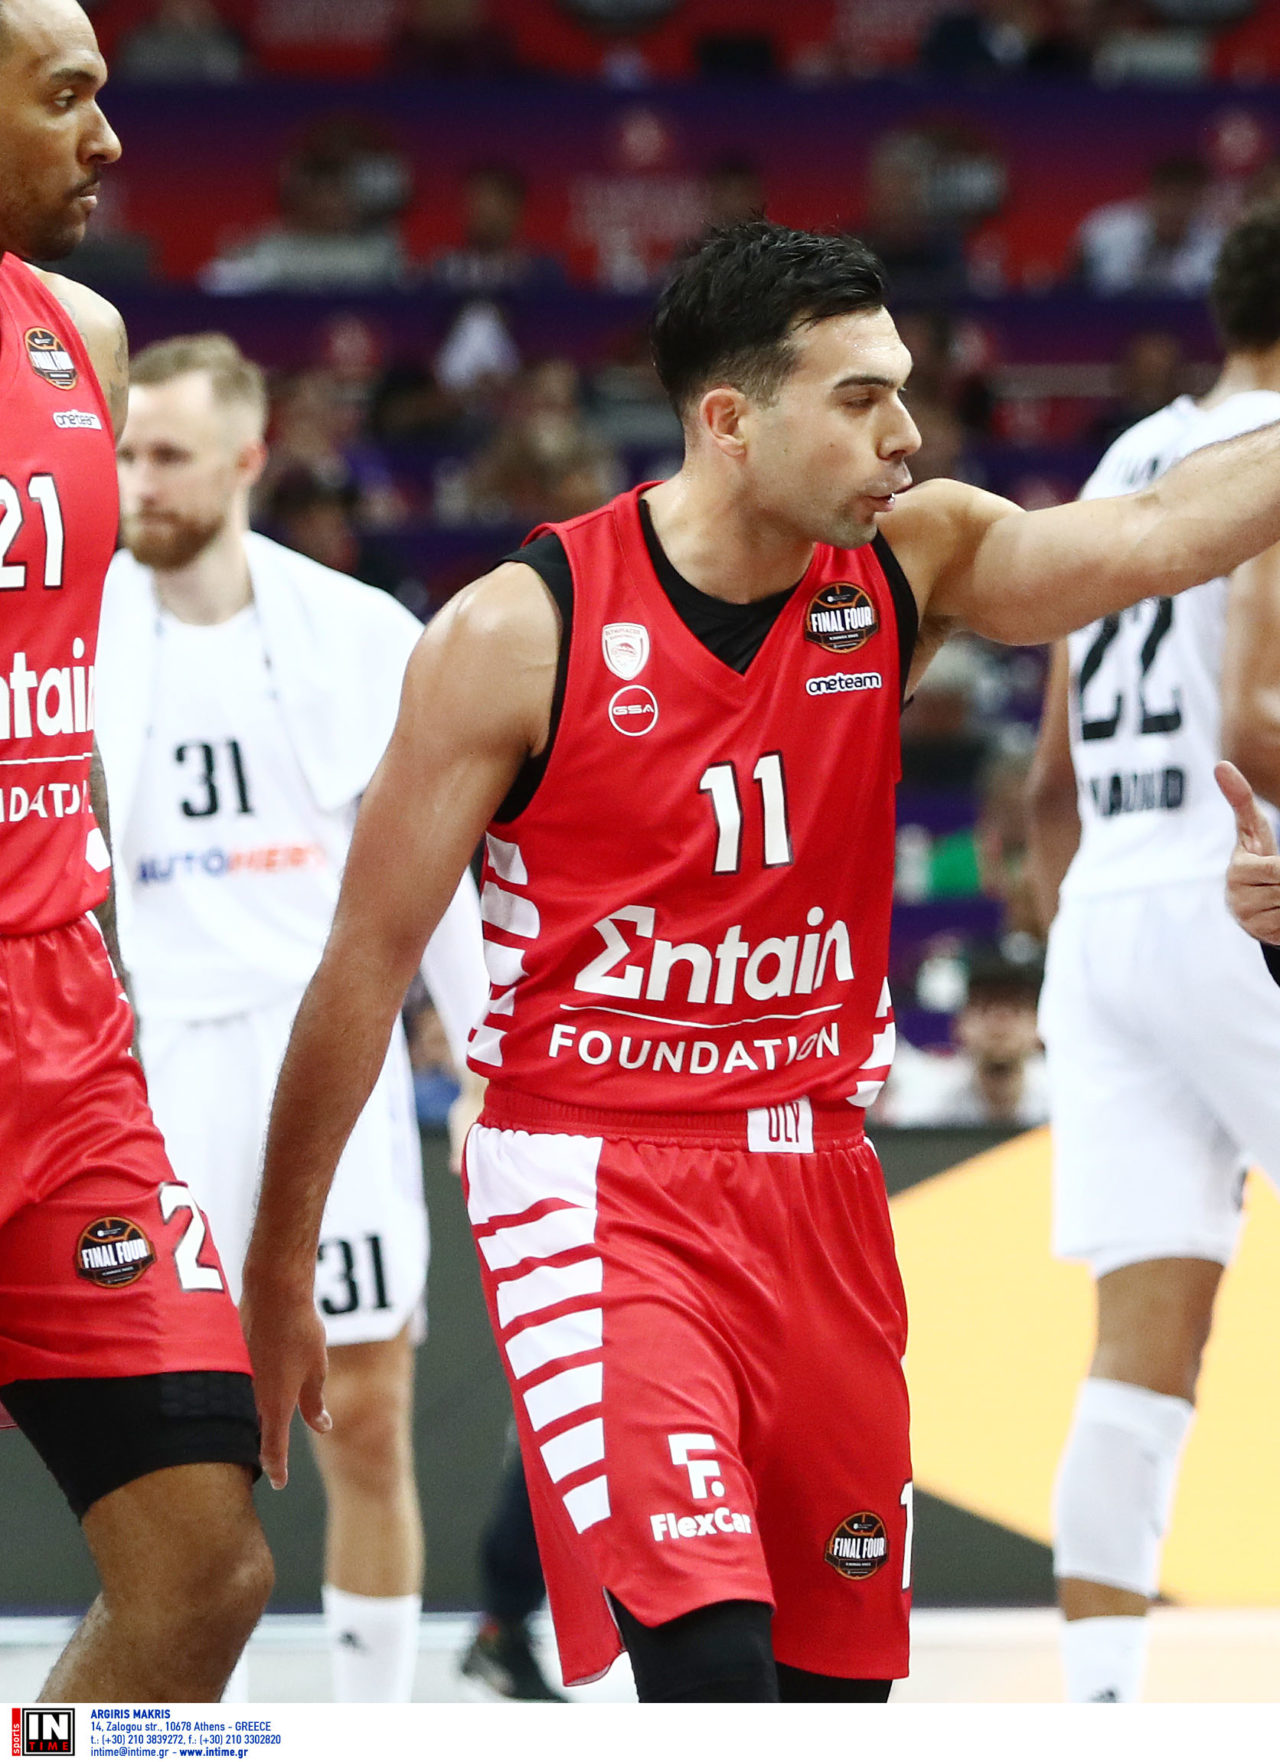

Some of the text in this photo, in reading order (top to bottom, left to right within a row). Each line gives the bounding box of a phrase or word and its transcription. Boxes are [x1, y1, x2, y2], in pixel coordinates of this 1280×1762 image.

[811, 607, 873, 632] FINAL FOUR
[808, 675, 879, 692] oneteam
[1080, 597, 1183, 741] 22
[613, 704, 654, 715] GSA
[175, 738, 254, 816] 31
[699, 750, 794, 875] 11
[548, 1023, 841, 1074] FOUNDATION
[82, 1239, 149, 1269] FINAL FOUR
[317, 1236, 391, 1315] 31
[650, 1507, 752, 1541] FlexCar
[834, 1537, 886, 1559] FINAL FOUR
